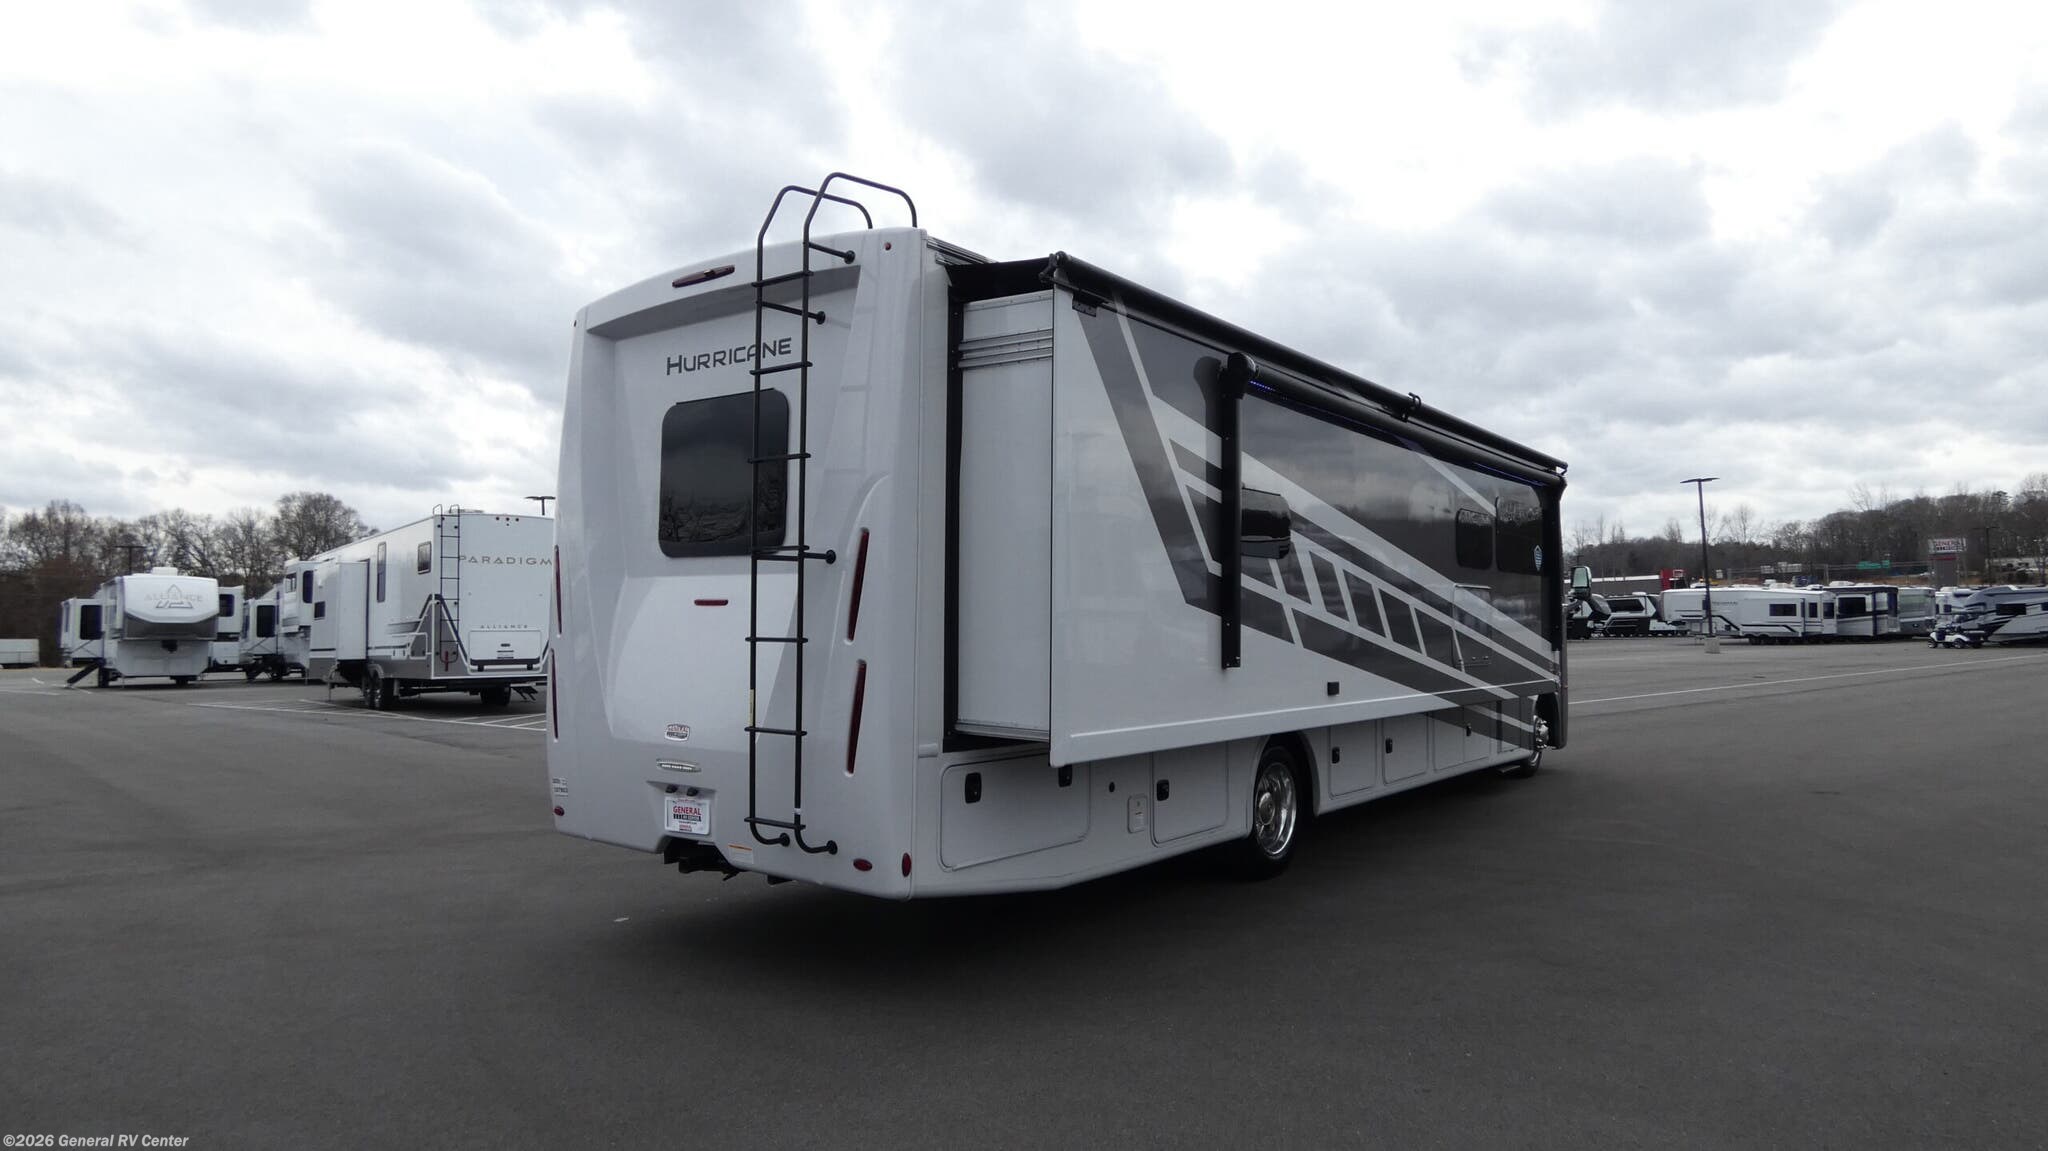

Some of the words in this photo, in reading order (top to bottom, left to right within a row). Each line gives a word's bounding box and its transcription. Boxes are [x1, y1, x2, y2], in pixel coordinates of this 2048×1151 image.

[666, 337, 792, 376] HURRICANE
[459, 555, 552, 566] PARADIGM
[672, 805, 702, 816] GENERAL
